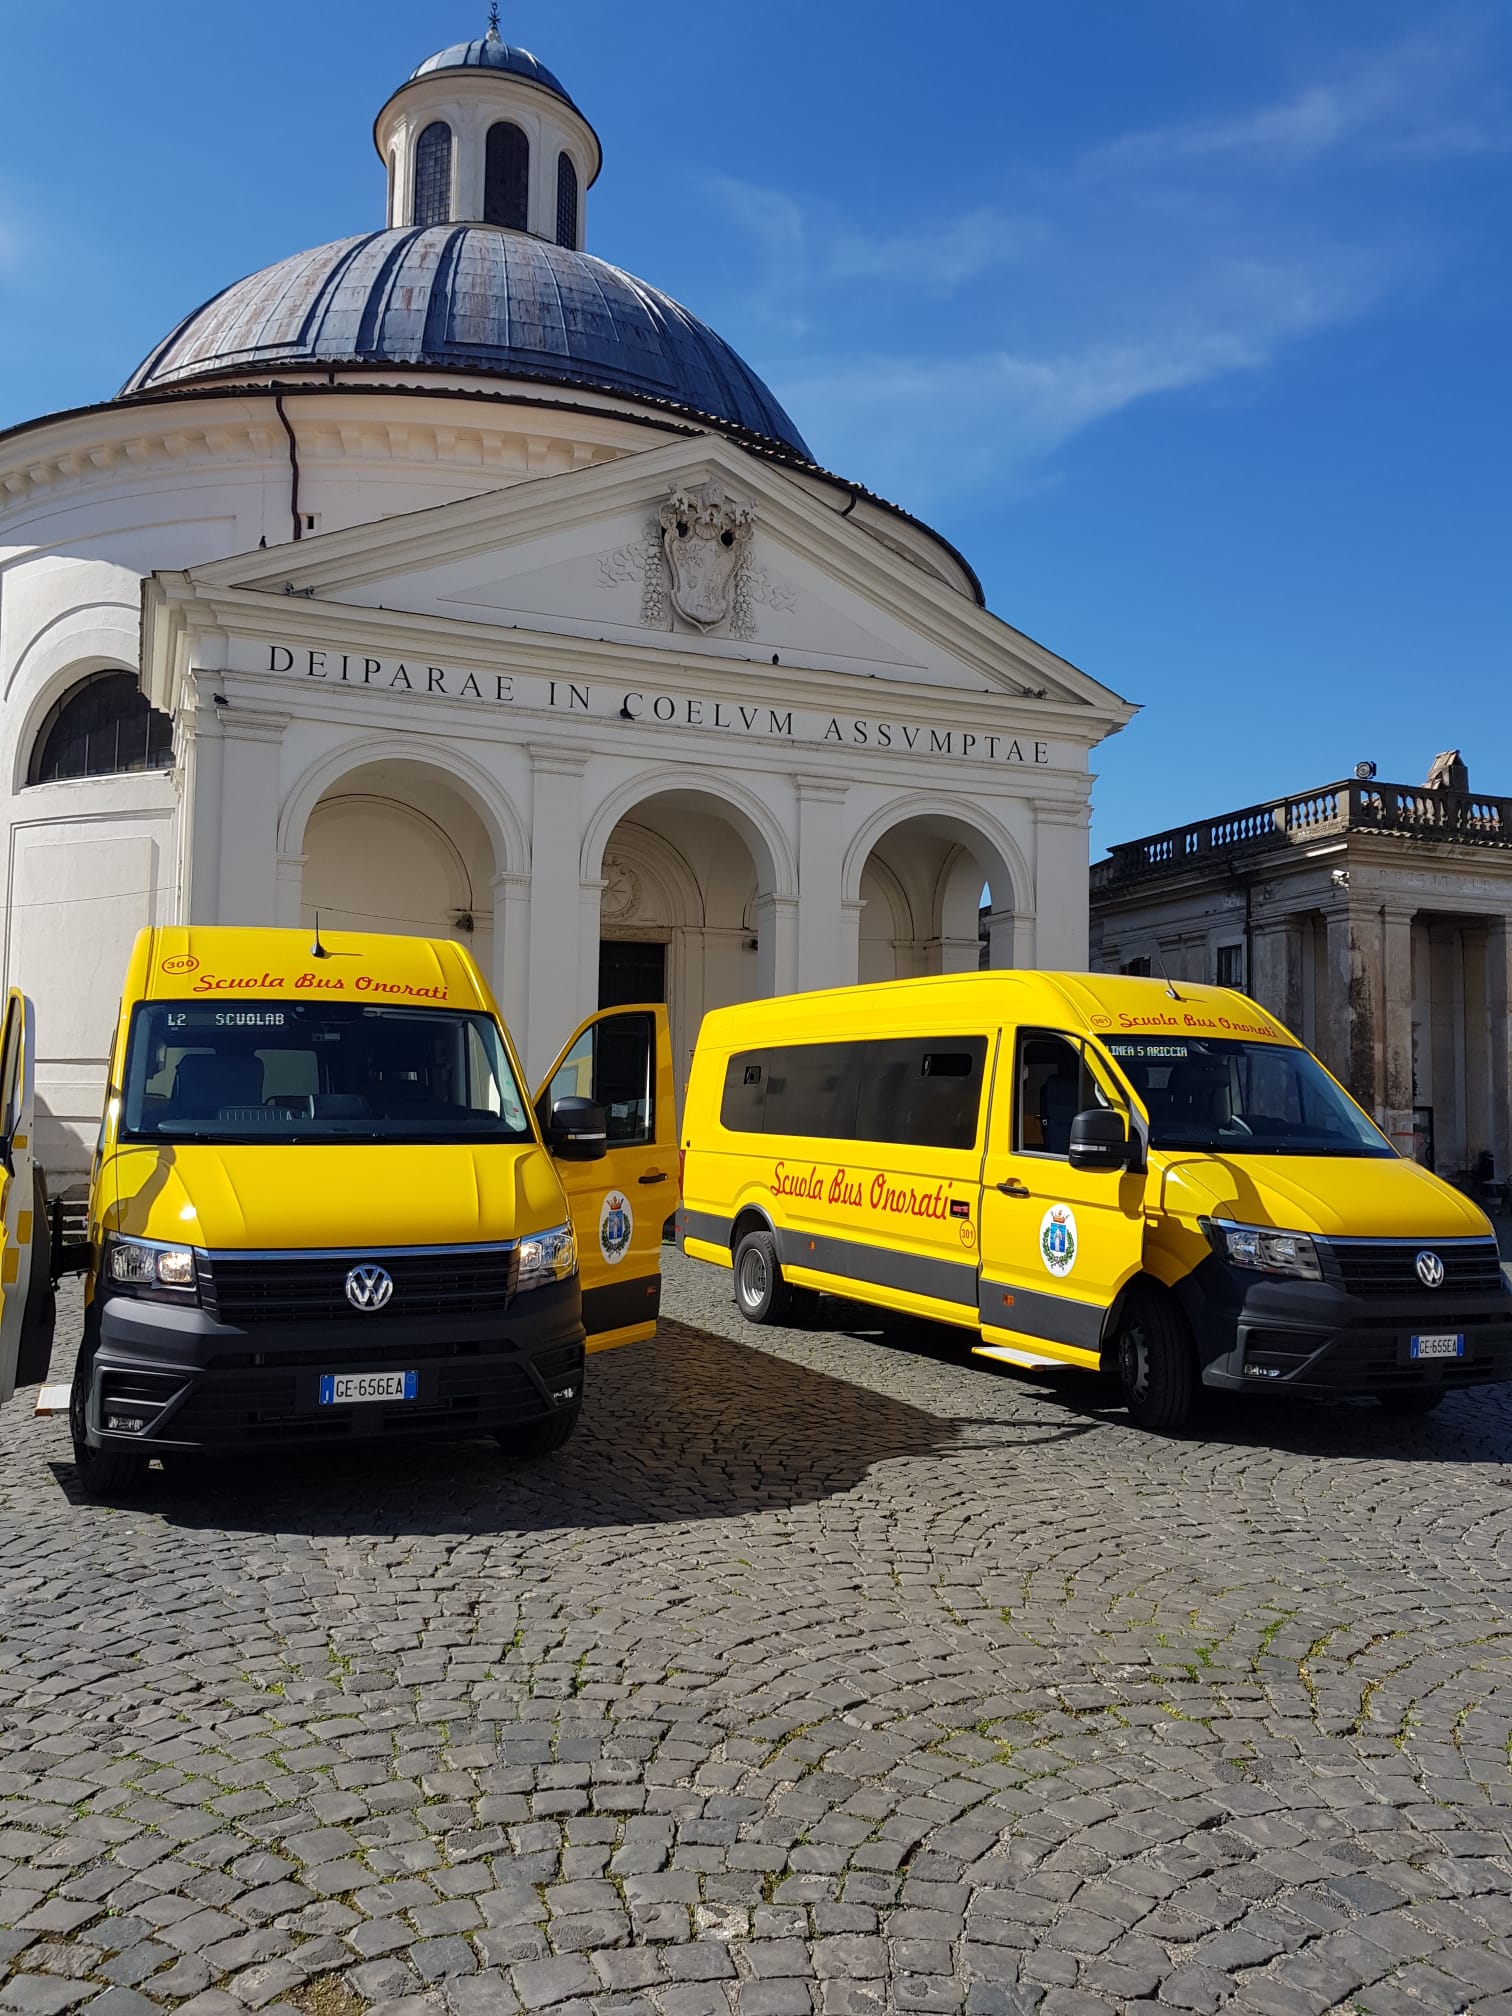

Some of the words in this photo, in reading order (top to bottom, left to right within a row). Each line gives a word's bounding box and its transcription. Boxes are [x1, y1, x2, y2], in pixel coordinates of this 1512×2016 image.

[267, 645, 514, 702] DEIPARAE
[548, 681, 591, 709] IN
[623, 691, 793, 736] COELVM
[824, 717, 1049, 764] ASSVMPTAE
[166, 959, 194, 969] 300
[193, 973, 284, 993] Scuola
[294, 973, 345, 989] Bus
[355, 976, 449, 1000] Onorati
[167, 1013, 187, 1026] L2
[215, 1013, 285, 1026] SCUOLAB
[1118, 1013, 1180, 1028] Scuola
[1183, 1014, 1217, 1028] Bus
[1218, 1017, 1278, 1038] Onorati
[1137, 1046, 1144, 1057] 5
[1147, 1046, 1188, 1057] ARICCIA
[770, 1161, 824, 1201] Scuola
[828, 1168, 863, 1207] Bus
[870, 1173, 953, 1220] Onorati
[961, 1228, 974, 1240] 301
